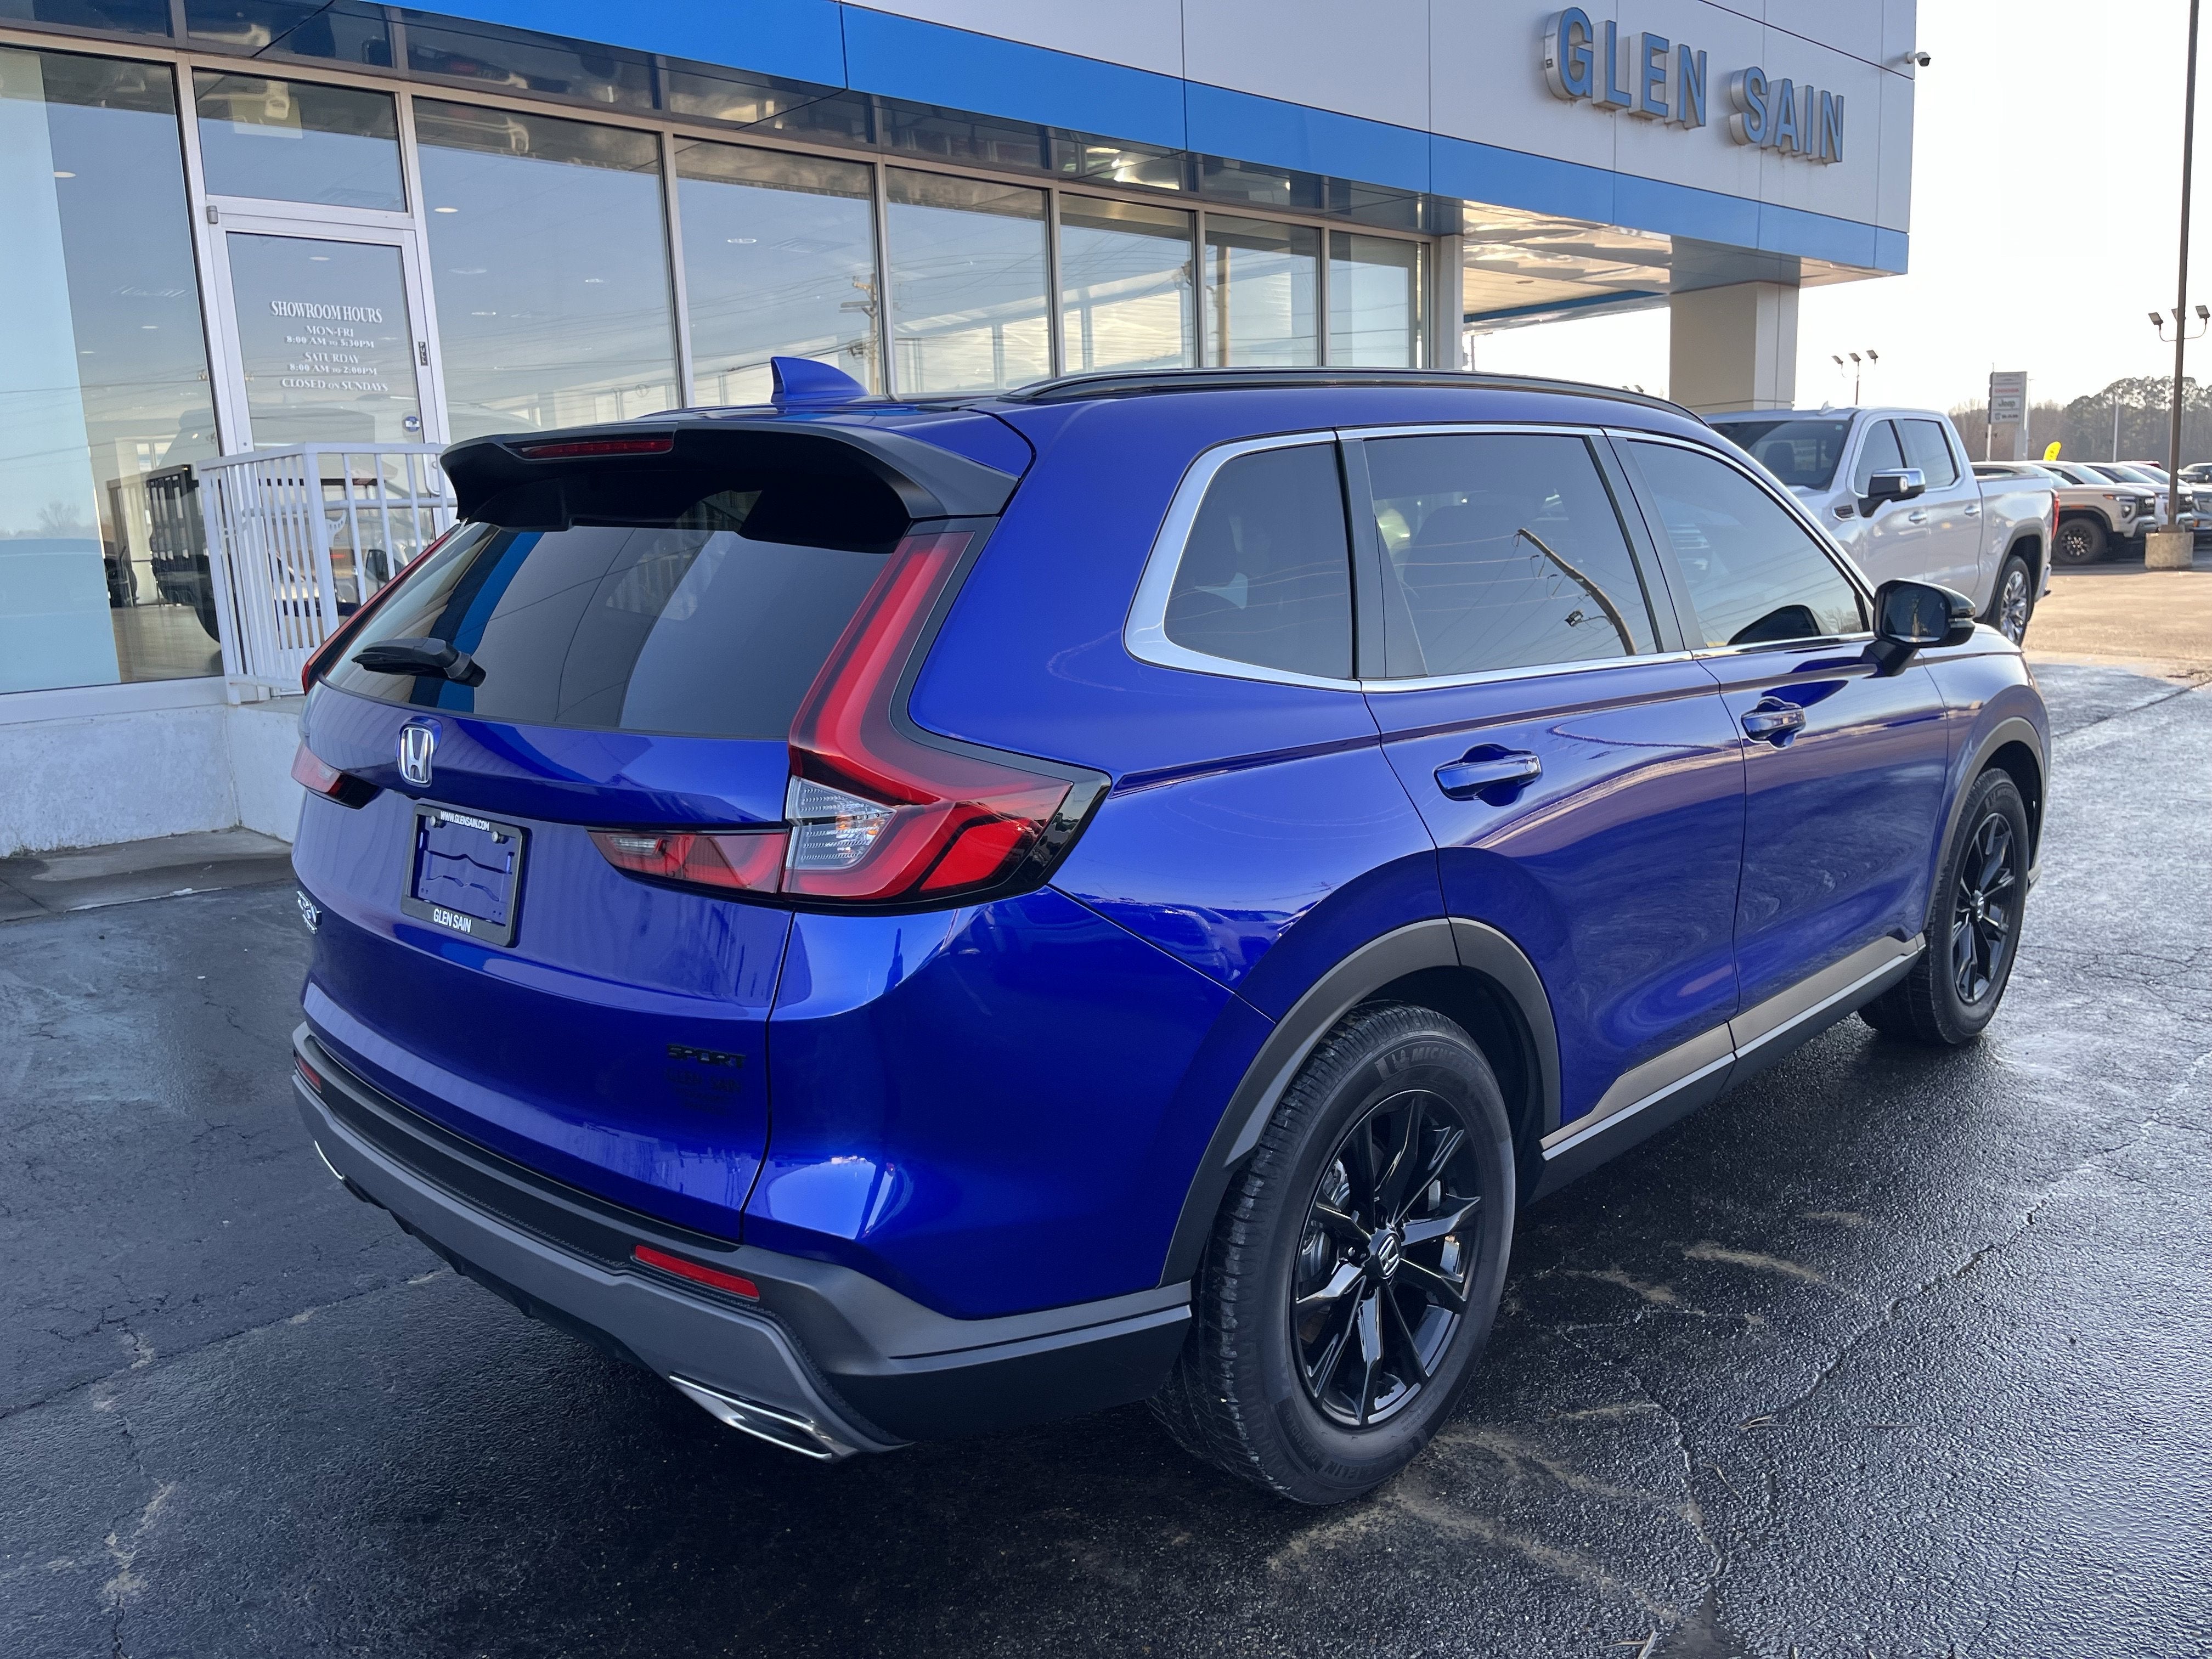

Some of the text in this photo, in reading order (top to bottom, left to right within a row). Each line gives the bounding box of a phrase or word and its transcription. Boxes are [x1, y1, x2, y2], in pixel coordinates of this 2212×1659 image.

[1545, 7, 1844, 164] GLEN SAIN
[271, 301, 382, 323] SHOWROOM HOURS
[306, 325, 354, 337] MON-FRI
[286, 335, 307, 344] 8:00
[309, 337, 326, 345] AM
[340, 338, 374, 348] 5:30PM
[304, 352, 359, 363] SATURDAY
[343, 366, 377, 375] 2:00PM
[281, 378, 325, 388] CLOSED
[342, 381, 388, 392] SUNDAYS
[440, 810, 489, 831] WWW.GLENSAIN.COM
[433, 908, 472, 933] GLEN SAIN
[667, 1043, 746, 1070] SPORT
